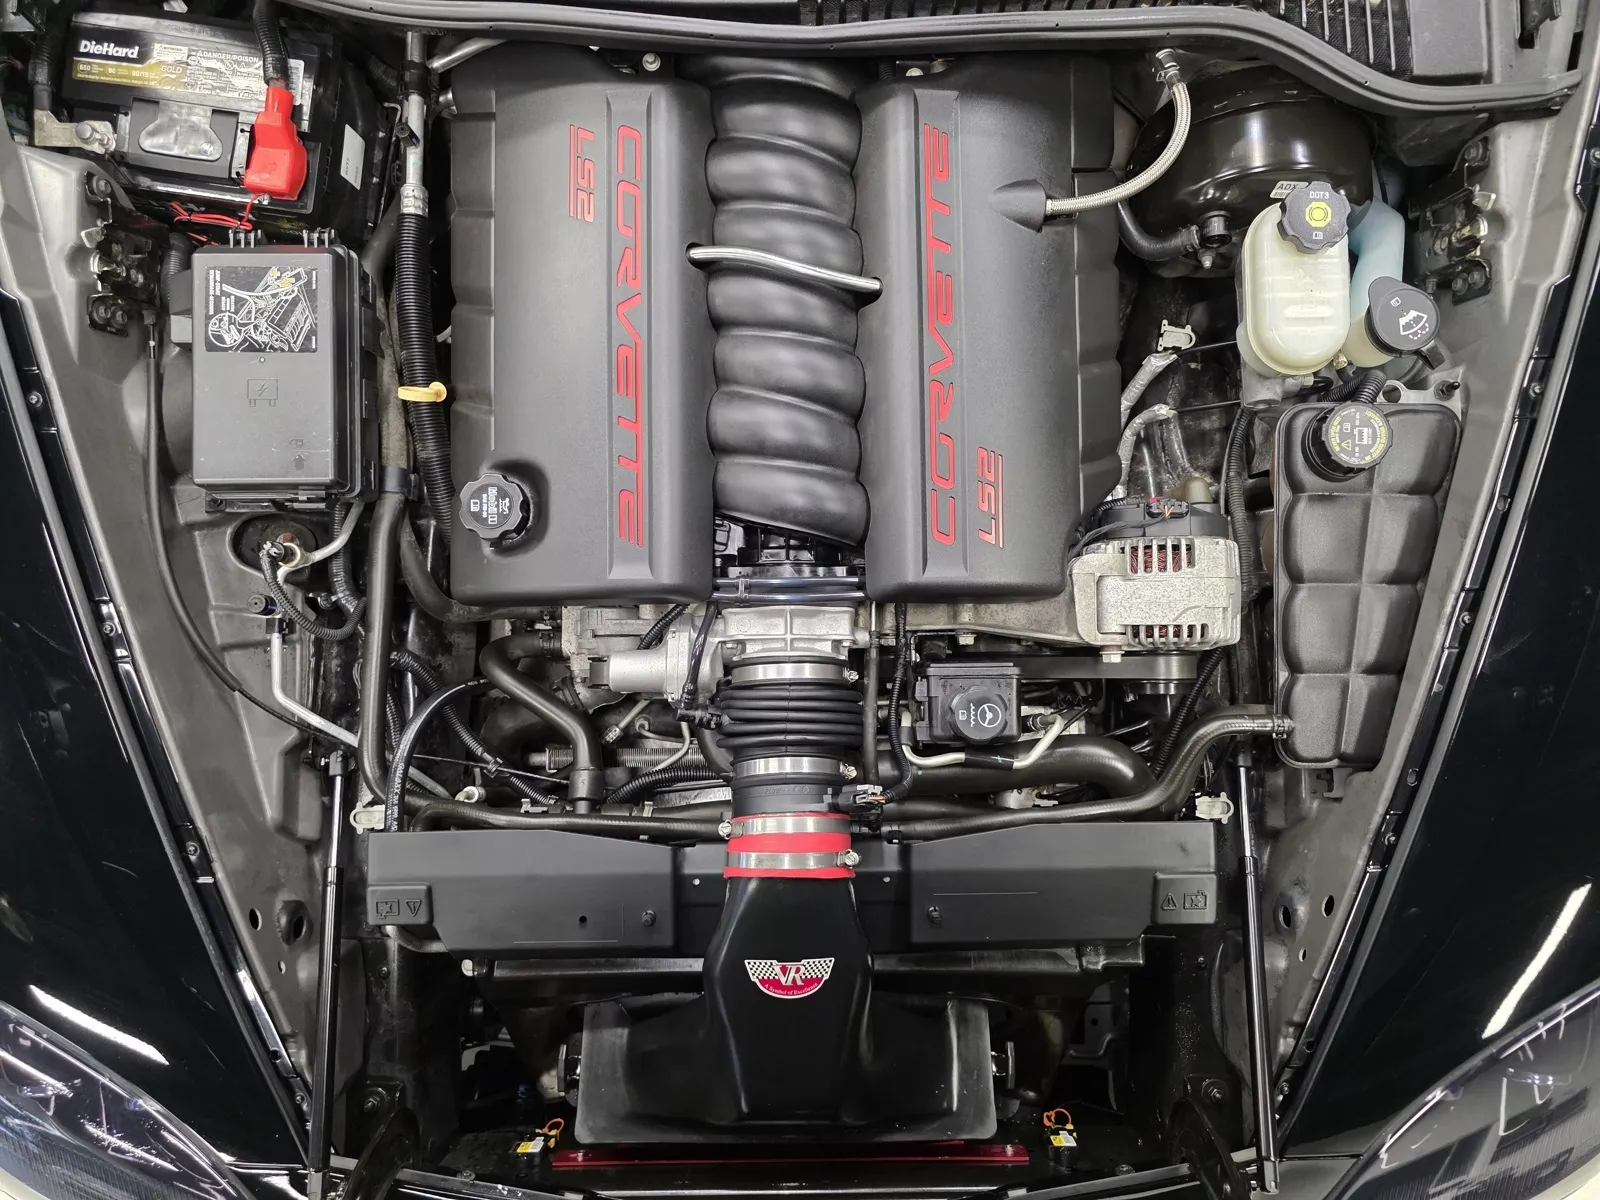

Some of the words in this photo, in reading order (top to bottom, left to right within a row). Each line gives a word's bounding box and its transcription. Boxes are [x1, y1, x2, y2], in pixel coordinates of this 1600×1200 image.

[80, 40, 139, 59] DieHard
[161, 65, 183, 74] GOLD
[576, 126, 595, 223] LS2
[1309, 191, 1330, 199] DOT3
[616, 124, 644, 548] CORVETTE
[924, 123, 956, 546] CORVETTE
[488, 486, 497, 513] Mobil
[977, 447, 996, 545] LS2
[771, 964, 806, 986] VR
[769, 986, 787, 995] Symbol
[794, 983, 818, 995] Excellence
